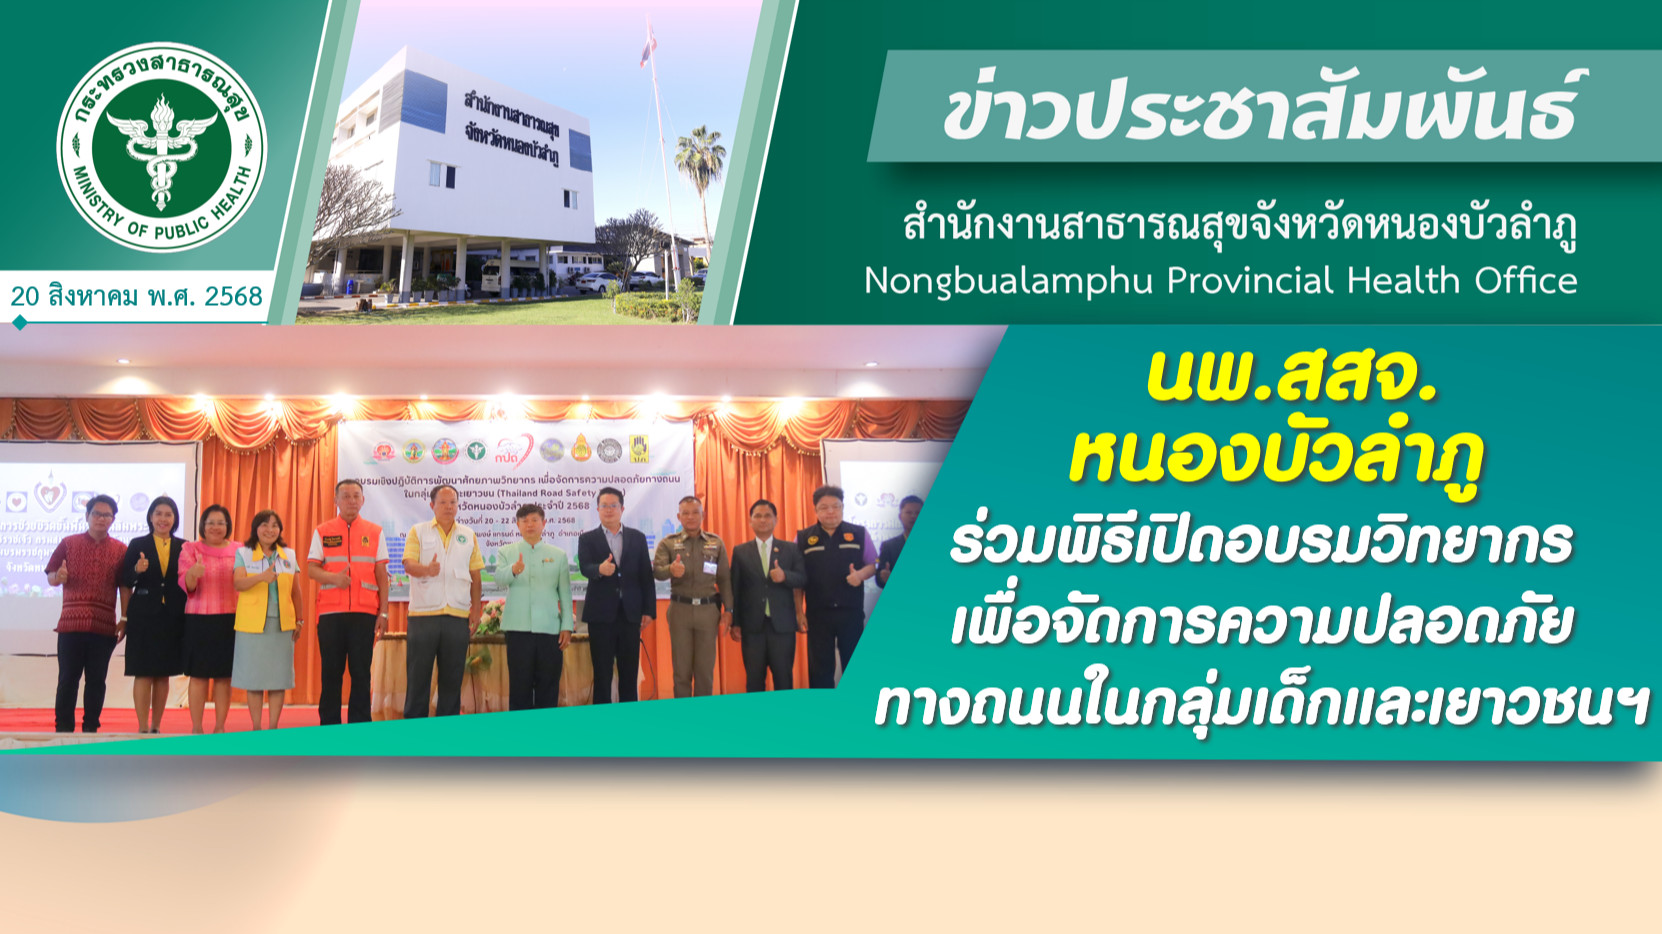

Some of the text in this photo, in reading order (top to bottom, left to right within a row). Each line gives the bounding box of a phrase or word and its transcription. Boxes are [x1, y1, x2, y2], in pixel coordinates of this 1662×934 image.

[464, 89, 560, 141] สำนักงานสาธารณสุข
[465, 120, 559, 168] จังหวัดหนองบัวลำภู
[497, 489, 538, 498] (Thailand
[566, 489, 597, 498] Safety
[567, 502, 590, 511] 2568
